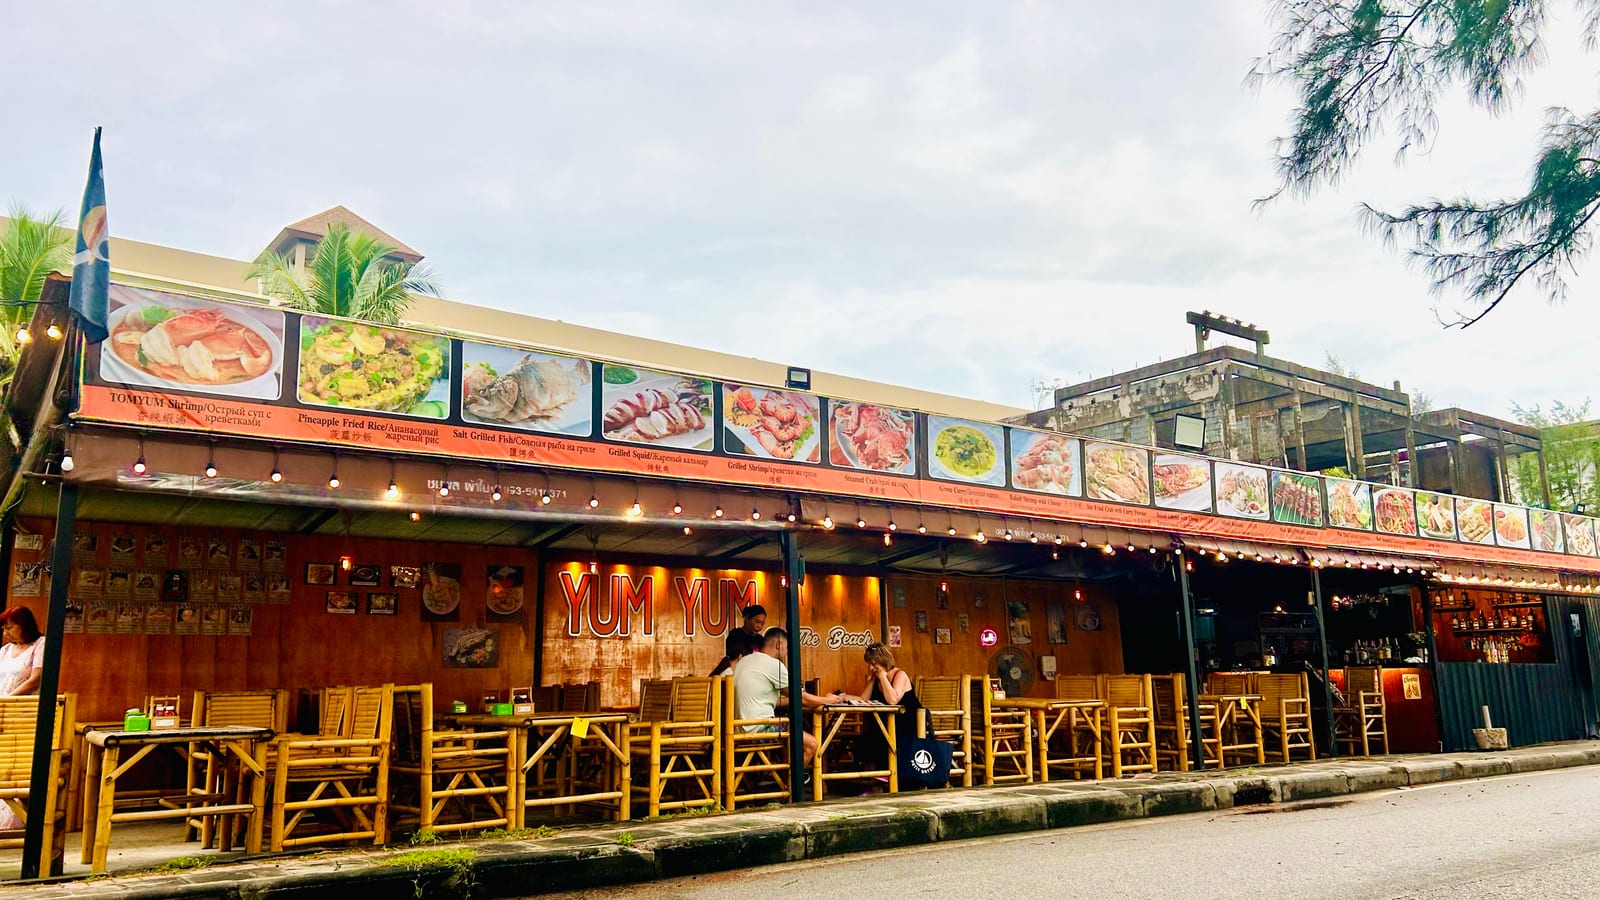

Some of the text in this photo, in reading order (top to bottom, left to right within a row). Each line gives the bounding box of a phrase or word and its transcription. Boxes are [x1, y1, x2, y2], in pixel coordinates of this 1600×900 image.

[110, 392, 164, 408] TOMYUM
[248, 409, 265, 419] суп
[205, 413, 261, 427] креветками
[298, 413, 340, 428] Pineapple
[343, 418, 365, 429] Fried
[385, 431, 440, 445] жареный рис
[453, 429, 468, 439] Salt
[470, 431, 496, 442] Grilled
[547, 440, 566, 451] рыба
[608, 447, 631, 458] Grilled
[727, 461, 747, 471] Grilled
[559, 571, 759, 638] YUM YUM
[800, 625, 821, 648] The
[826, 625, 874, 651] Beach
